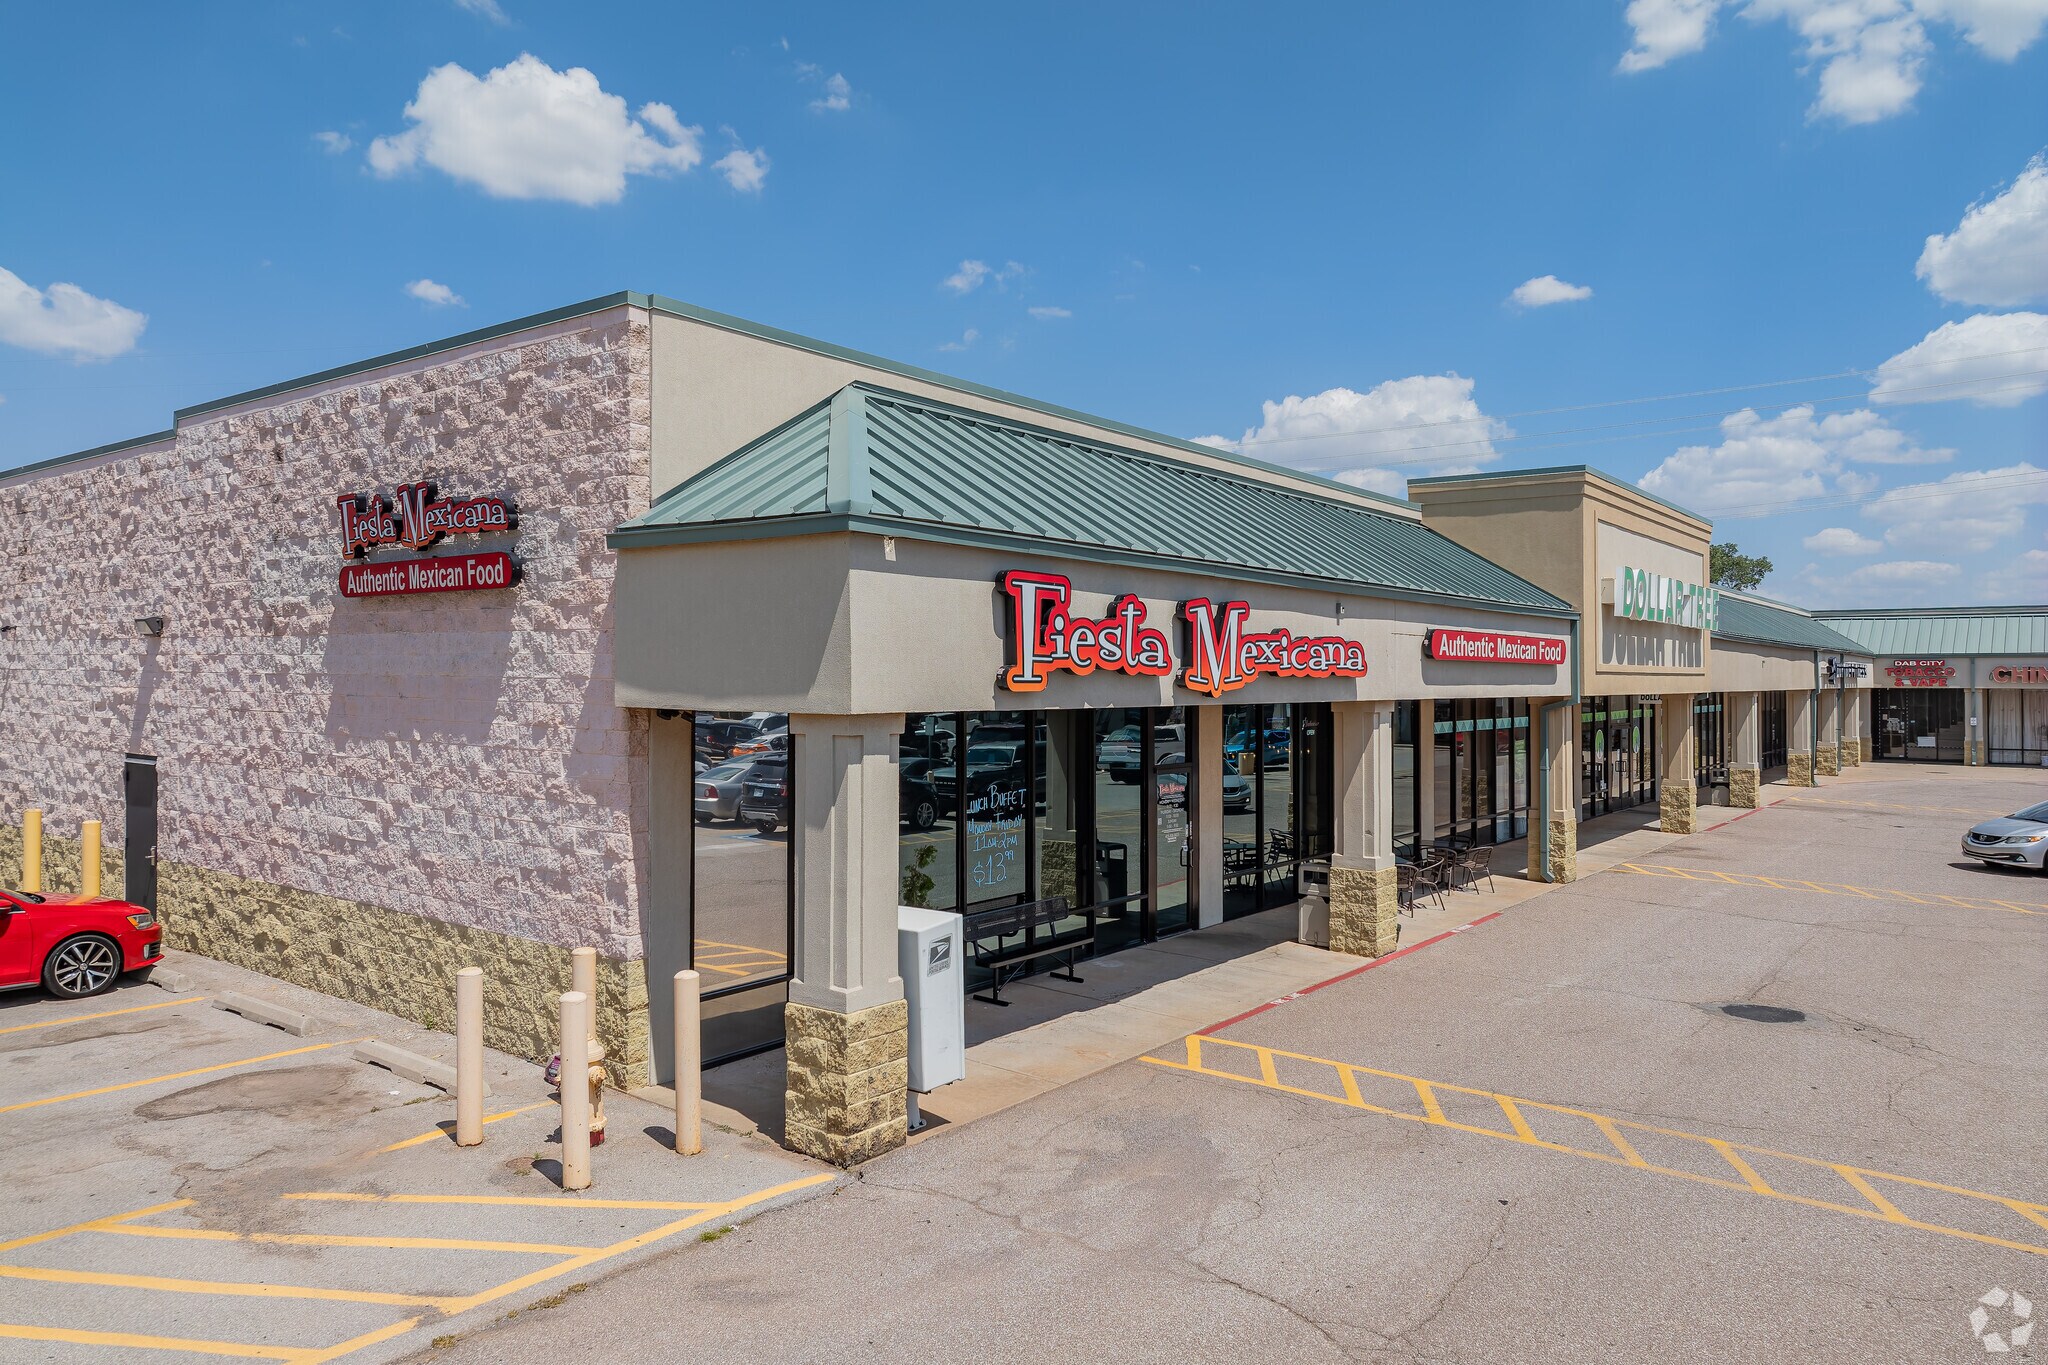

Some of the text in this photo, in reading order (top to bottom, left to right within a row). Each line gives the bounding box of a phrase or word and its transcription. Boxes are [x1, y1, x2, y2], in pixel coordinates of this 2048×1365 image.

[339, 487, 507, 556] Fiesta Mexicana
[347, 557, 504, 594] Authentic Mexican Food
[1622, 565, 1720, 632] DOLLAR TREE
[1011, 579, 1366, 691] Fiesta Mexicana
[1439, 633, 1562, 661] Authentic Mexican Food
[1884, 667, 1956, 677] TOBACCO
[1894, 678, 1948, 687] & VAPE
